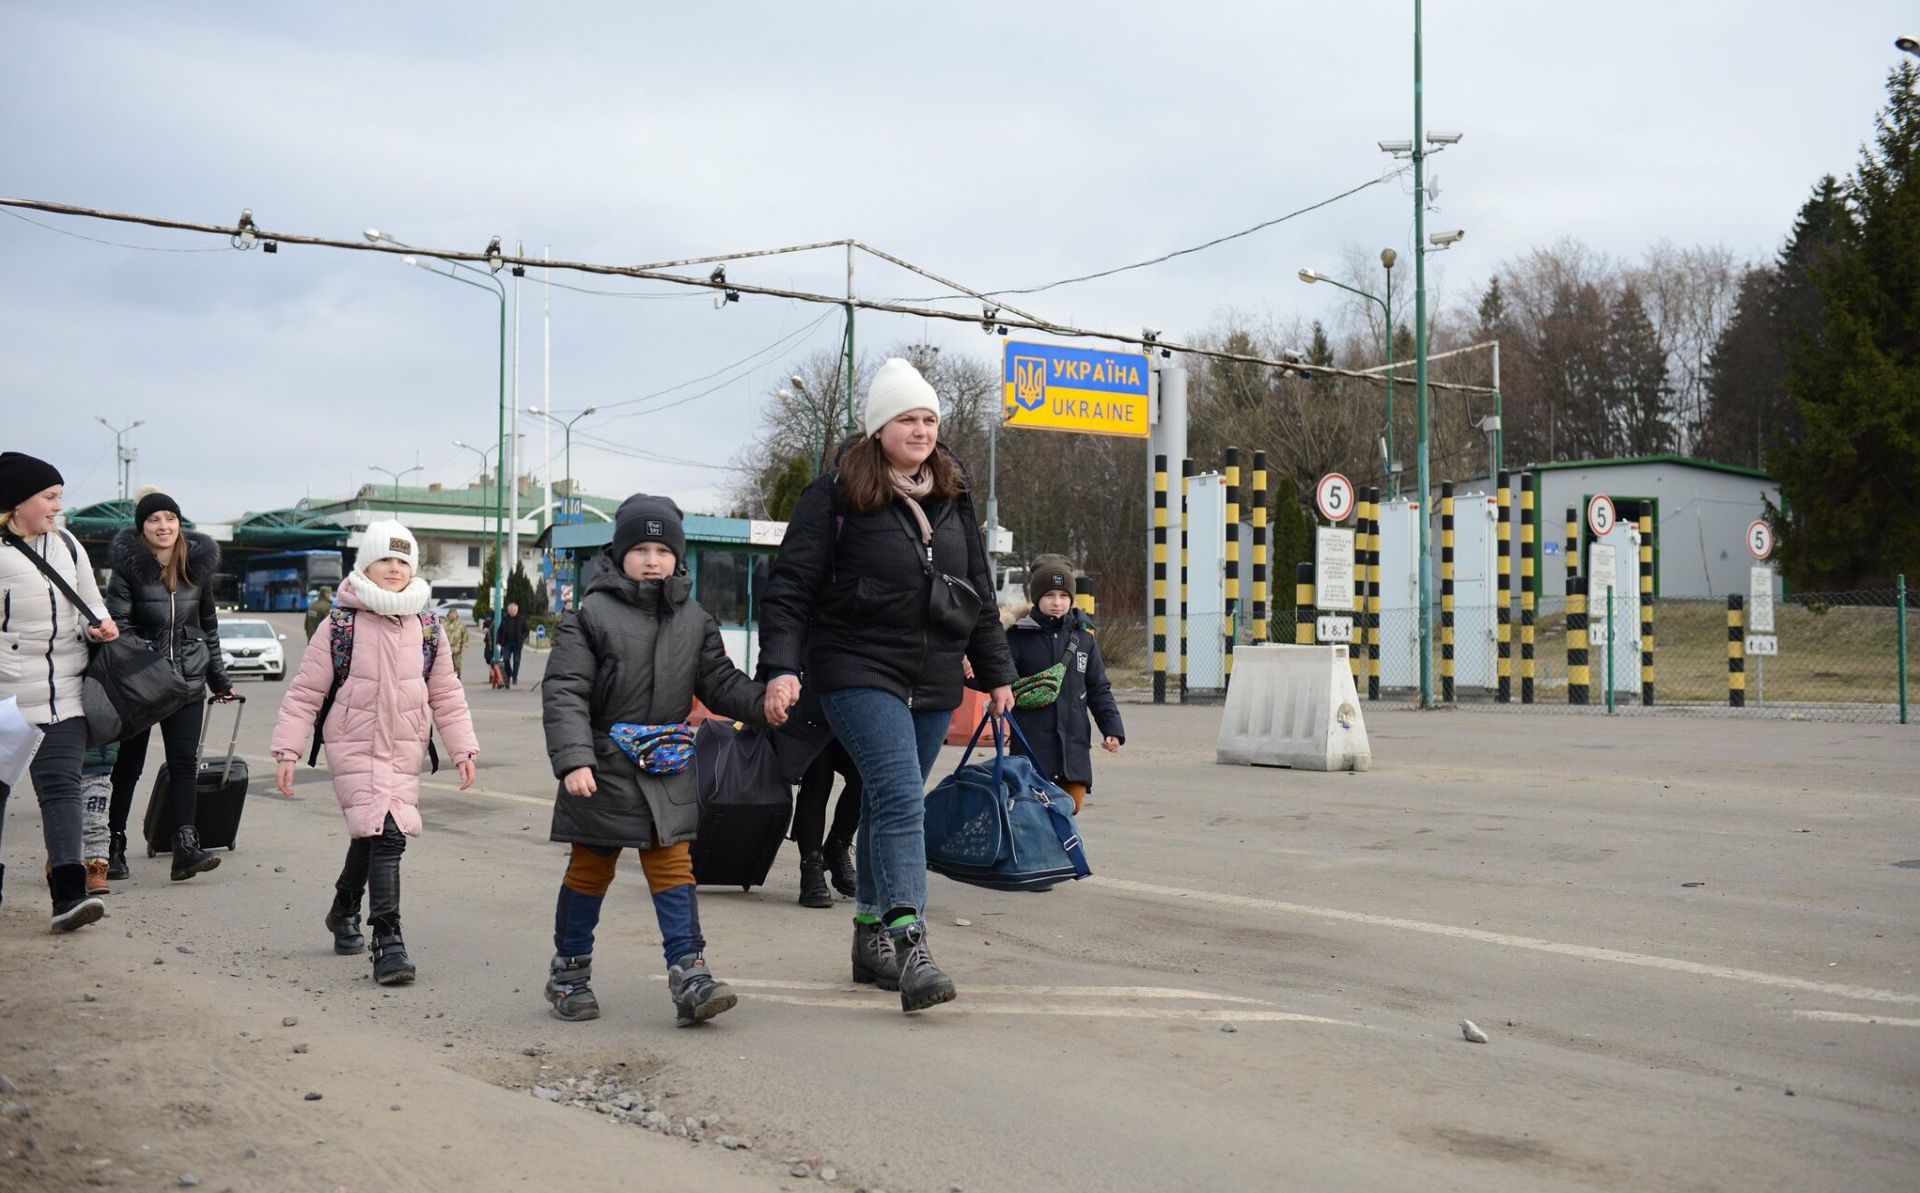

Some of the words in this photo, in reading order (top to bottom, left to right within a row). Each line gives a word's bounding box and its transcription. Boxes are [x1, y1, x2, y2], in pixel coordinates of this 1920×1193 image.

[1052, 358, 1140, 386] УКРАЇНА
[1052, 398, 1135, 422] UKRAINE
[1329, 485, 1342, 510] 5
[1597, 506, 1606, 528] 5
[1755, 531, 1763, 550] 5
